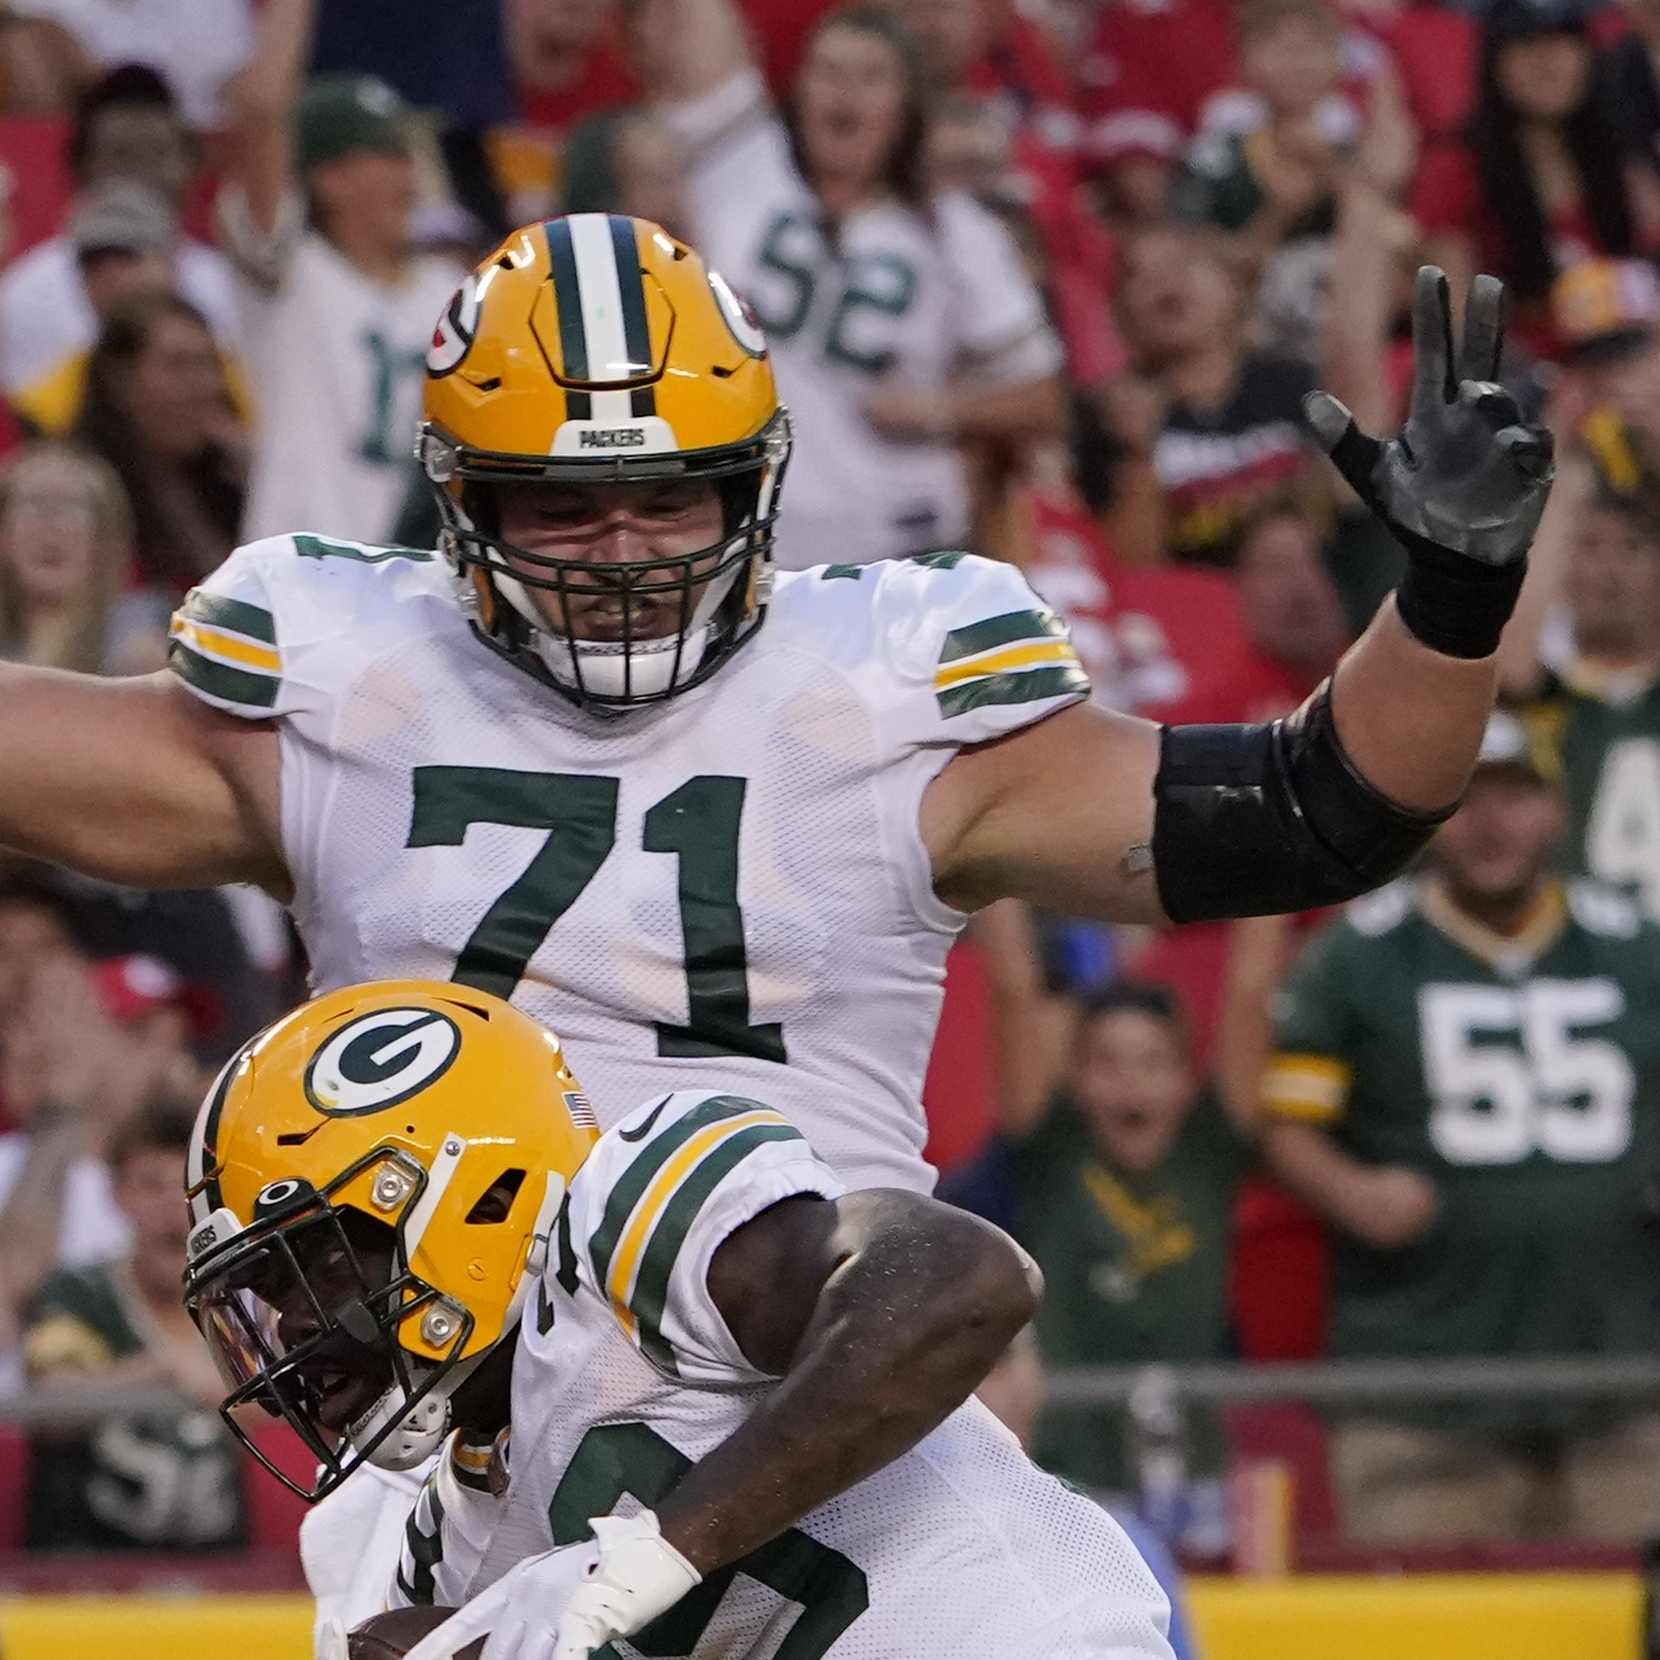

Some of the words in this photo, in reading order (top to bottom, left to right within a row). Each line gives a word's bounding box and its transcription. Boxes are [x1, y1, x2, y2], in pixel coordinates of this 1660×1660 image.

[741, 212, 917, 374] 52
[355, 322, 427, 466] 1
[579, 428, 645, 449] PACKERS
[405, 765, 788, 1063] 71
[304, 1006, 461, 1118] G
[1418, 971, 1636, 1167] 55
